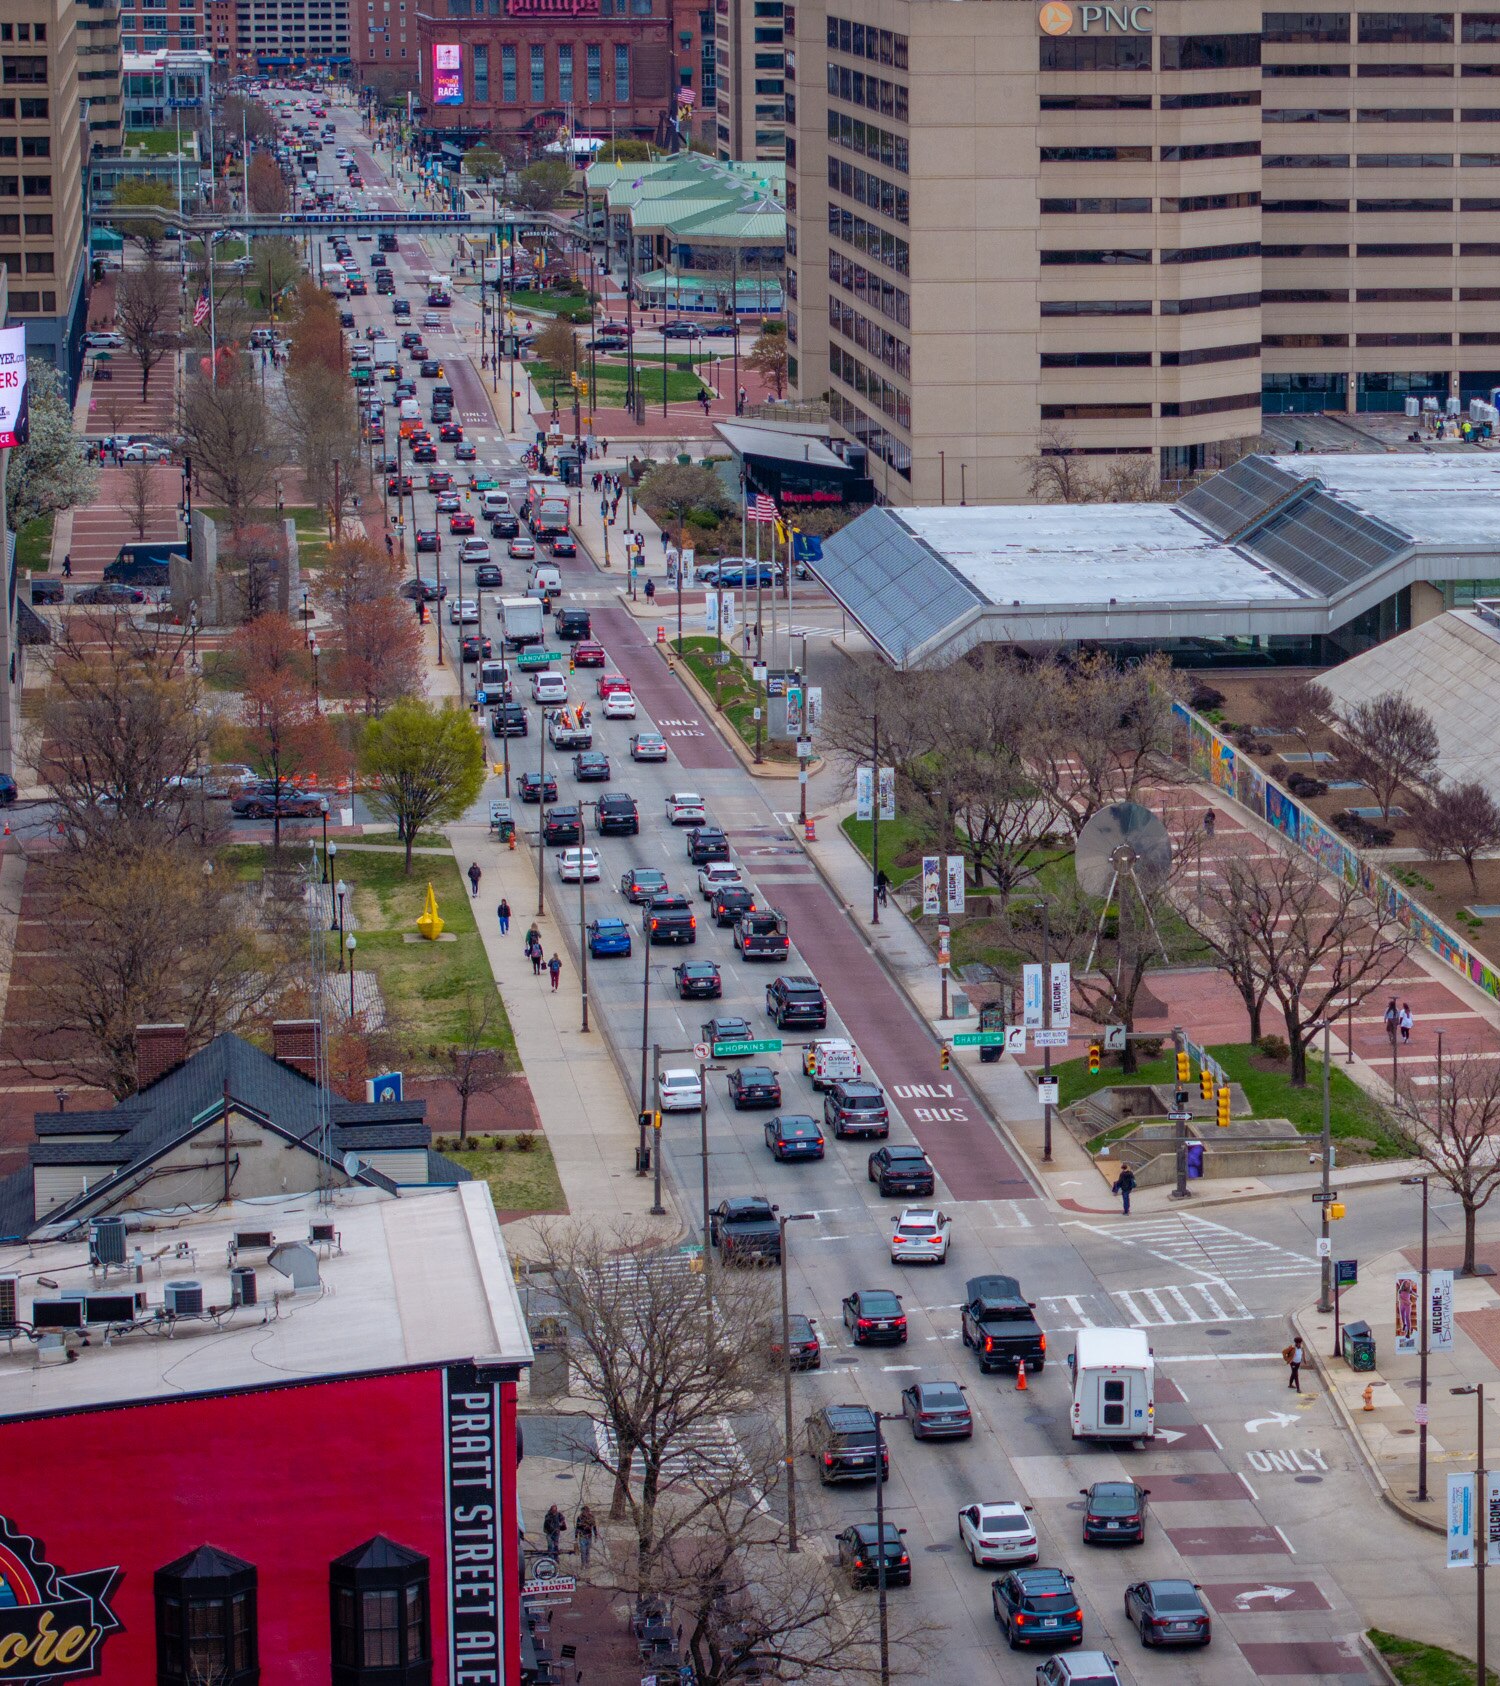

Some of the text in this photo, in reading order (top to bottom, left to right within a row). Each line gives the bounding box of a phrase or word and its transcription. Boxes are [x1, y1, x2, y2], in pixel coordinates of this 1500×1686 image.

[1079, 5, 1153, 31] PNC
[438, 87, 461, 96] RACE.
[518, 654, 550, 662] HANOVER
[1053, 981, 1061, 1013] WELCOME
[725, 1044, 765, 1052] HOPKINS
[956, 1036, 982, 1044] SHARP
[893, 1084, 954, 1098] ONLY
[913, 1108, 969, 1122] BUS
[1433, 1295, 1442, 1334] WELCOME
[1246, 1449, 1328, 1472] ONLY
[1490, 1498, 1500, 1543] WELCOME
[450, 1393, 496, 1685] PRATT STREET ALE
